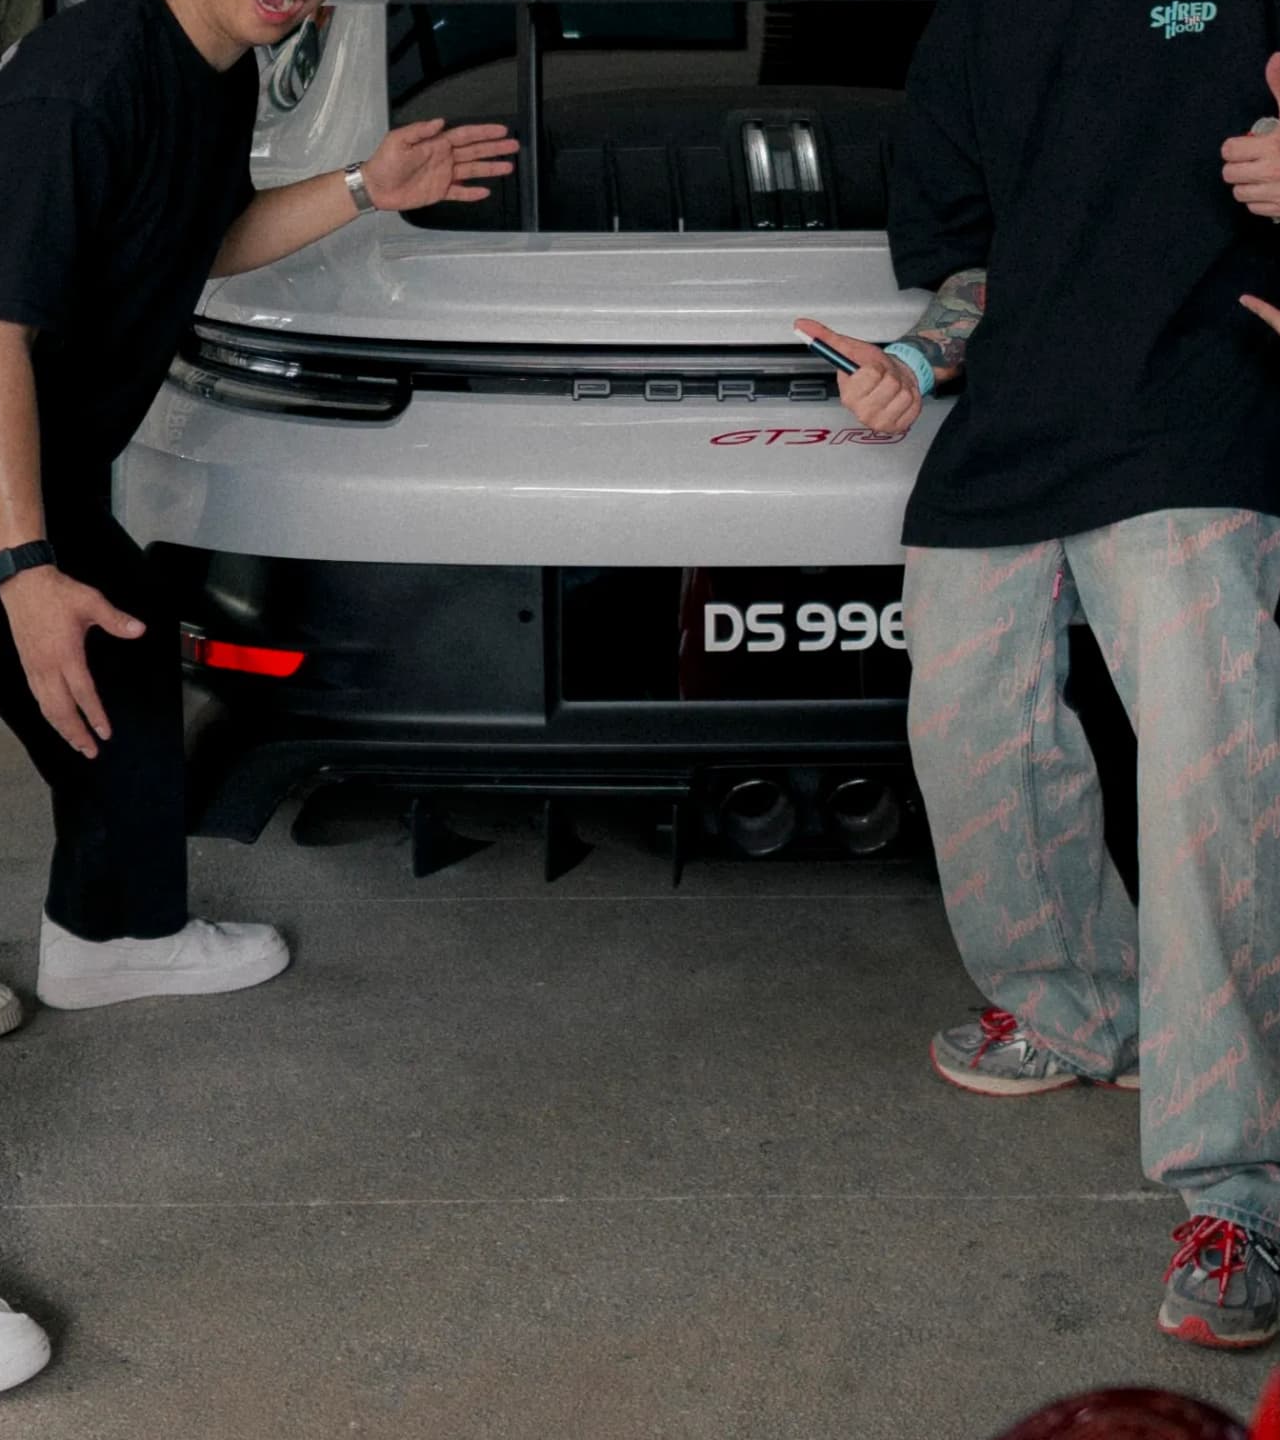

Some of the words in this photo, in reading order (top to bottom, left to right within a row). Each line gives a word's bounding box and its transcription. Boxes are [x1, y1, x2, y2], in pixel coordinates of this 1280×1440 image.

[1150, 0, 1218, 28] SHRED
[1165, 22, 1206, 40] HOOD
[572, 379, 828, 402] PORS
